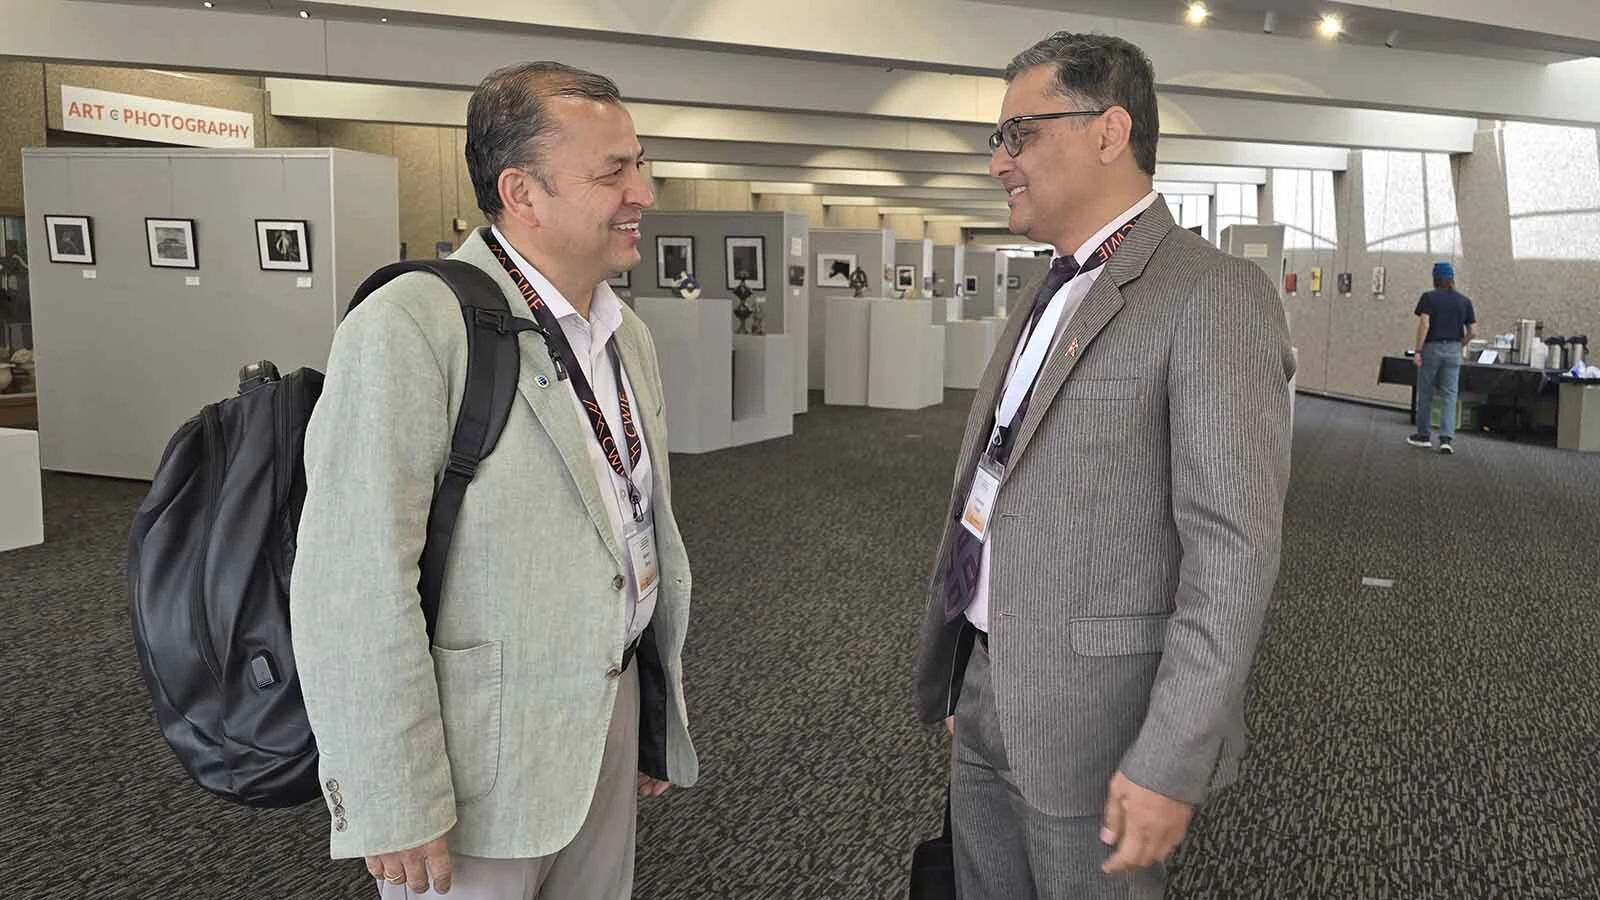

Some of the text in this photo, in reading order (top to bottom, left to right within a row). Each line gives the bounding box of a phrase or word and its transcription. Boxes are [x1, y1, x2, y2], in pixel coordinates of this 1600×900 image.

[68, 102, 105, 120] ART
[122, 108, 250, 139] PHOTOGRAPHY
[508, 267, 545, 311] CWIE
[618, 391, 637, 438] CWIE
[602, 436, 625, 476] CWI
